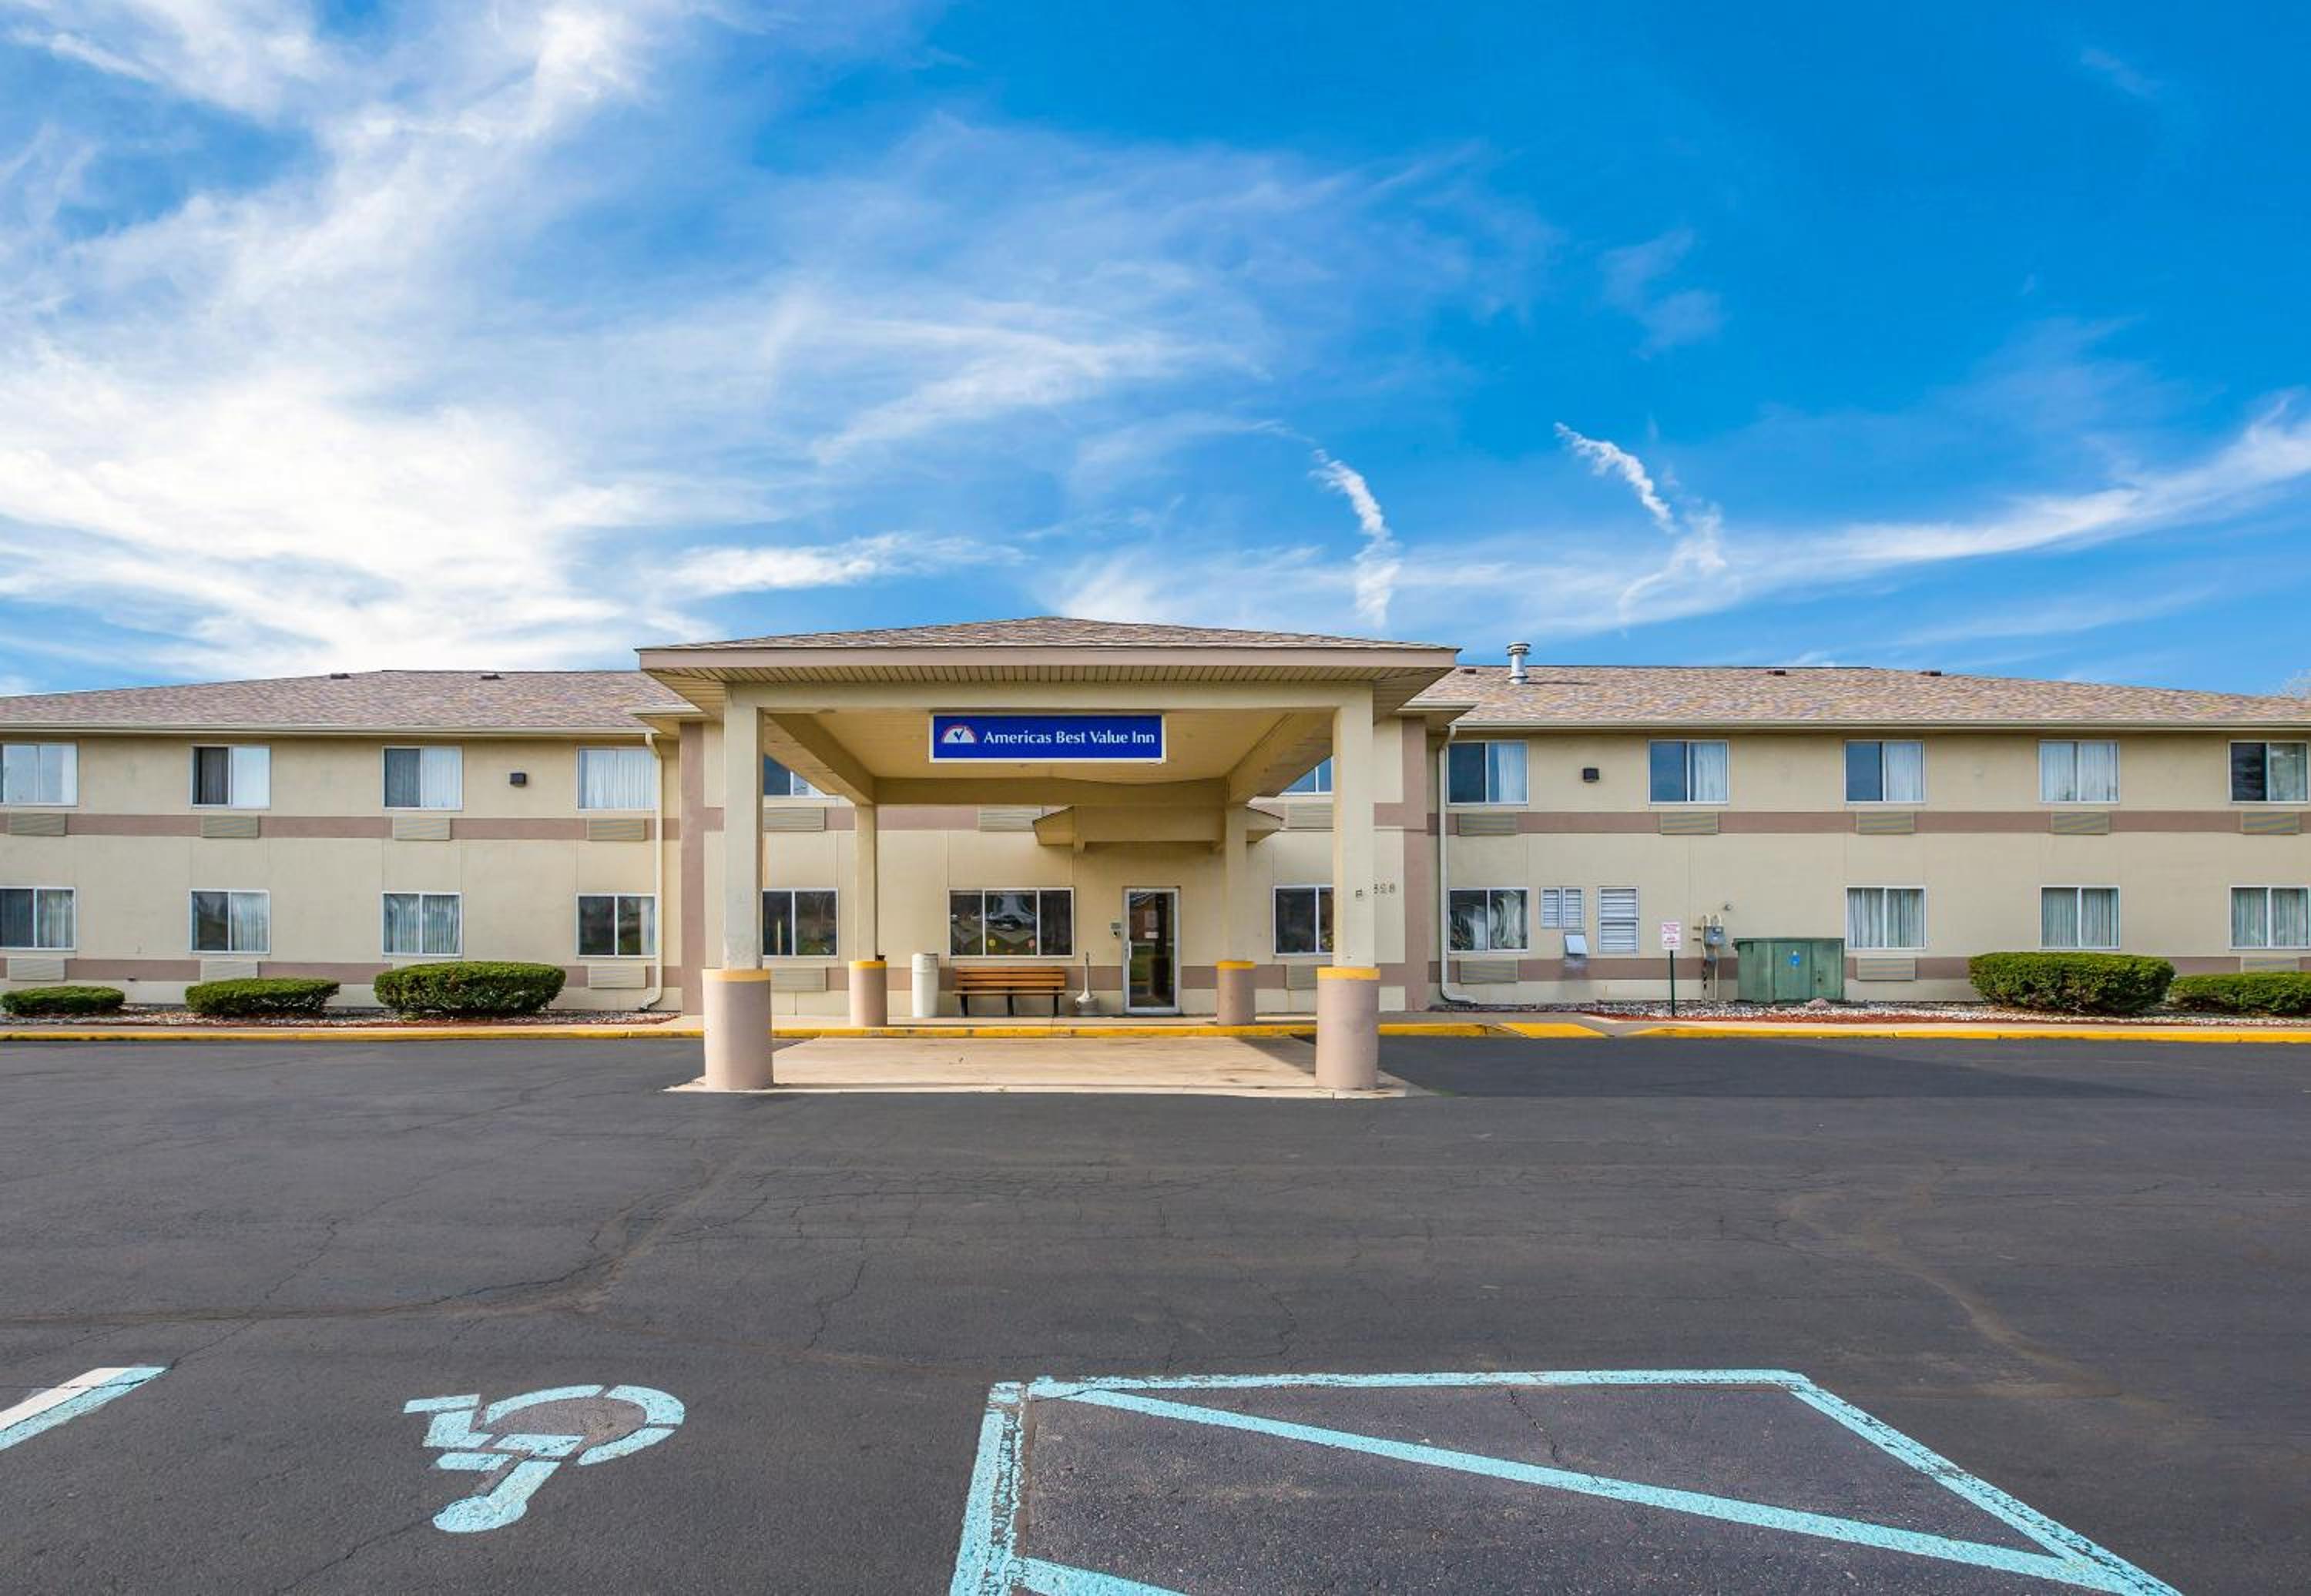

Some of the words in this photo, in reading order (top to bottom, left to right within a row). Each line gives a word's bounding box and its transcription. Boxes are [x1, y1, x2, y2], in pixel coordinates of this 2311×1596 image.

[984, 729, 1052, 743] Americas
[1056, 731, 1085, 743] Best
[1090, 729, 1129, 743] Value
[1132, 731, 1155, 743] Inn
